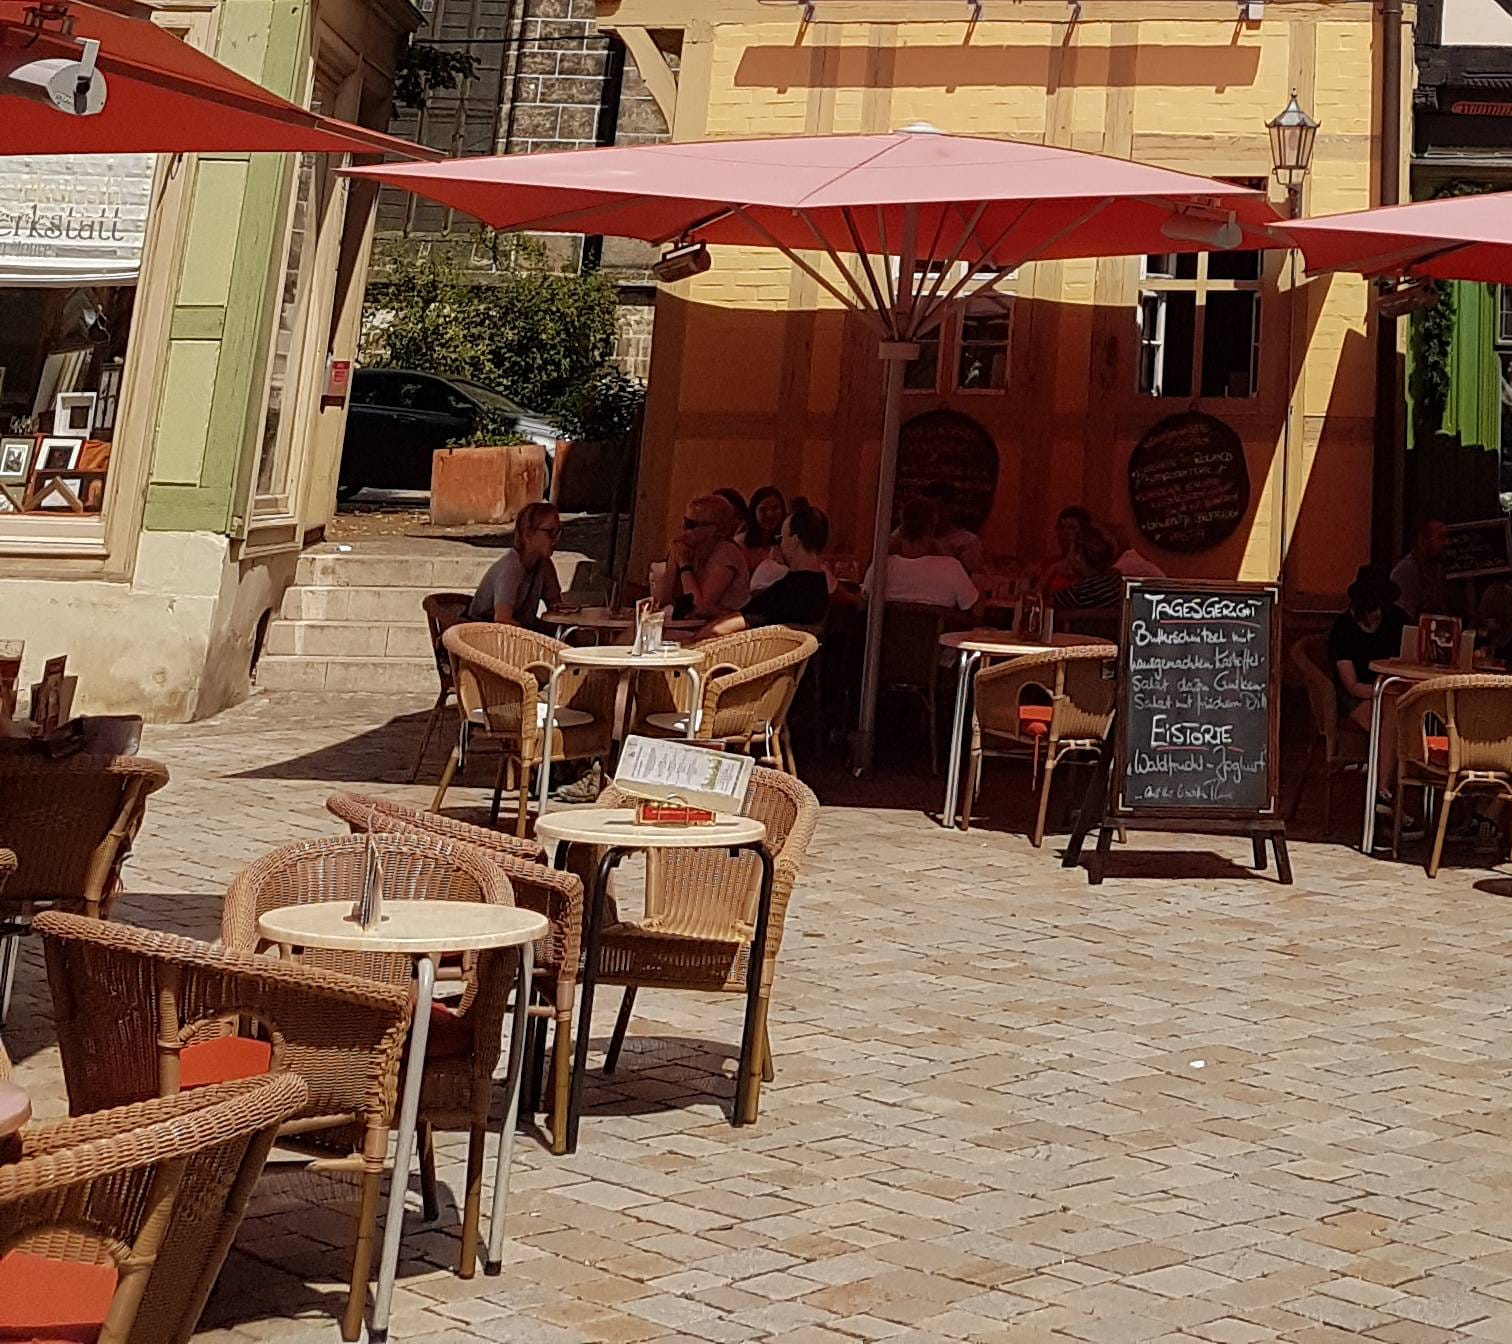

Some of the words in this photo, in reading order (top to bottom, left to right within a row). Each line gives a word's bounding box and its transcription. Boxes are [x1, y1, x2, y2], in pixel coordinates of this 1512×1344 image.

[1231, 627, 1256, 644] mit
[1131, 675, 1170, 692] Salat
[1133, 693, 1172, 710] Salat
